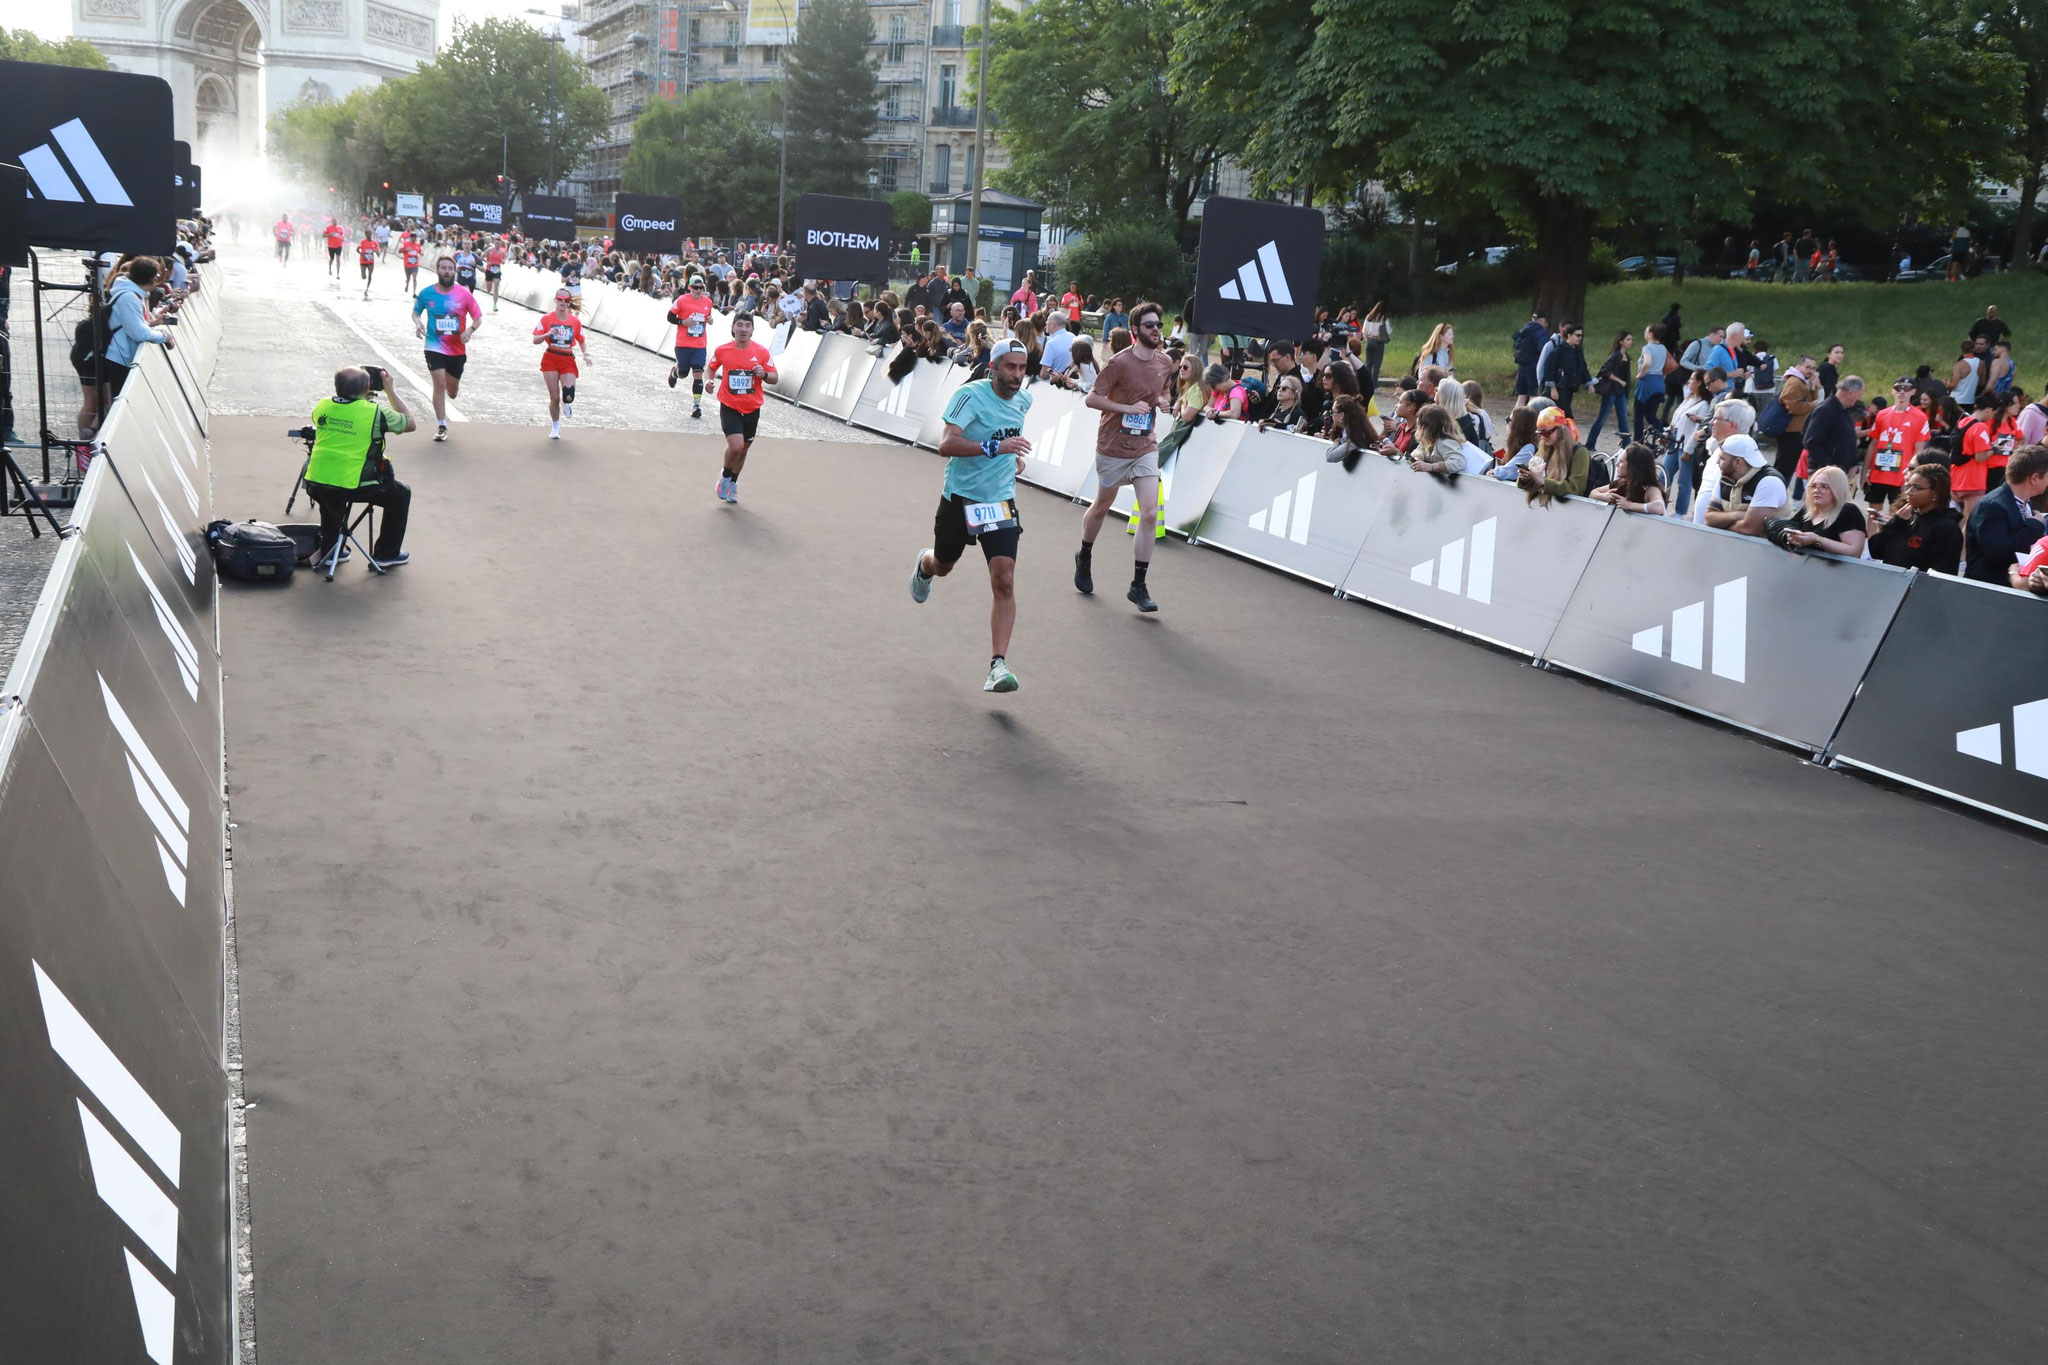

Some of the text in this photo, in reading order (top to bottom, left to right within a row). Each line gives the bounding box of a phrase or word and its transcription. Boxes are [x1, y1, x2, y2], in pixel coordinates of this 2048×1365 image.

[469, 202, 503, 214] POWER
[621, 214, 675, 232] Compeed
[807, 229, 880, 250] BIOTHERM
[731, 377, 750, 388] 3892
[974, 505, 997, 521] 9711
